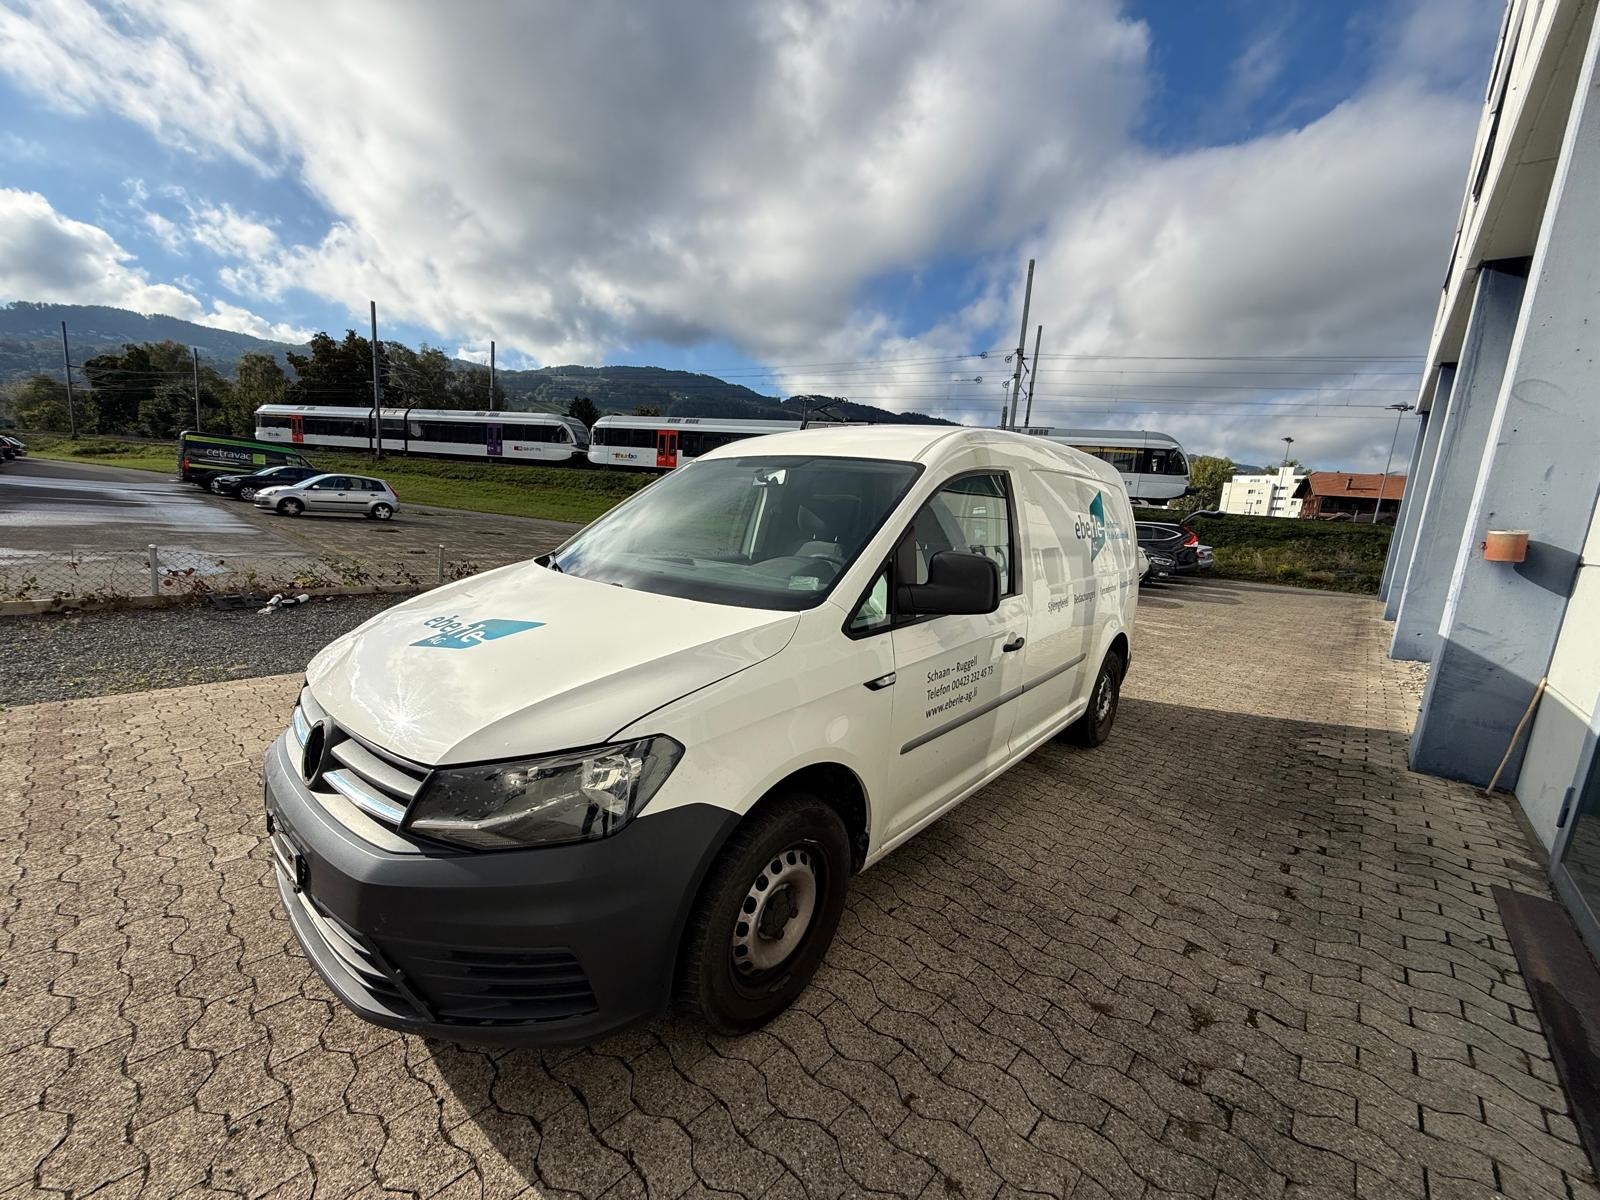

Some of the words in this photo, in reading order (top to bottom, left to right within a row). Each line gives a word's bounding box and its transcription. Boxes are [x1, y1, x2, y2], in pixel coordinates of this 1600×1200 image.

[206, 448, 251, 460] cetravac
[1075, 514, 1104, 539] eberle
[423, 615, 486, 643] eberle
[927, 668, 950, 683] Schaan
[956, 656, 977, 672] Ruggell
[927, 684, 950, 700] Telefon
[951, 674, 970, 690] 00423
[970, 670, 980, 683] 232
[980, 667, 987, 677] 45
[926, 686, 977, 718] www.eberle-ag.li
